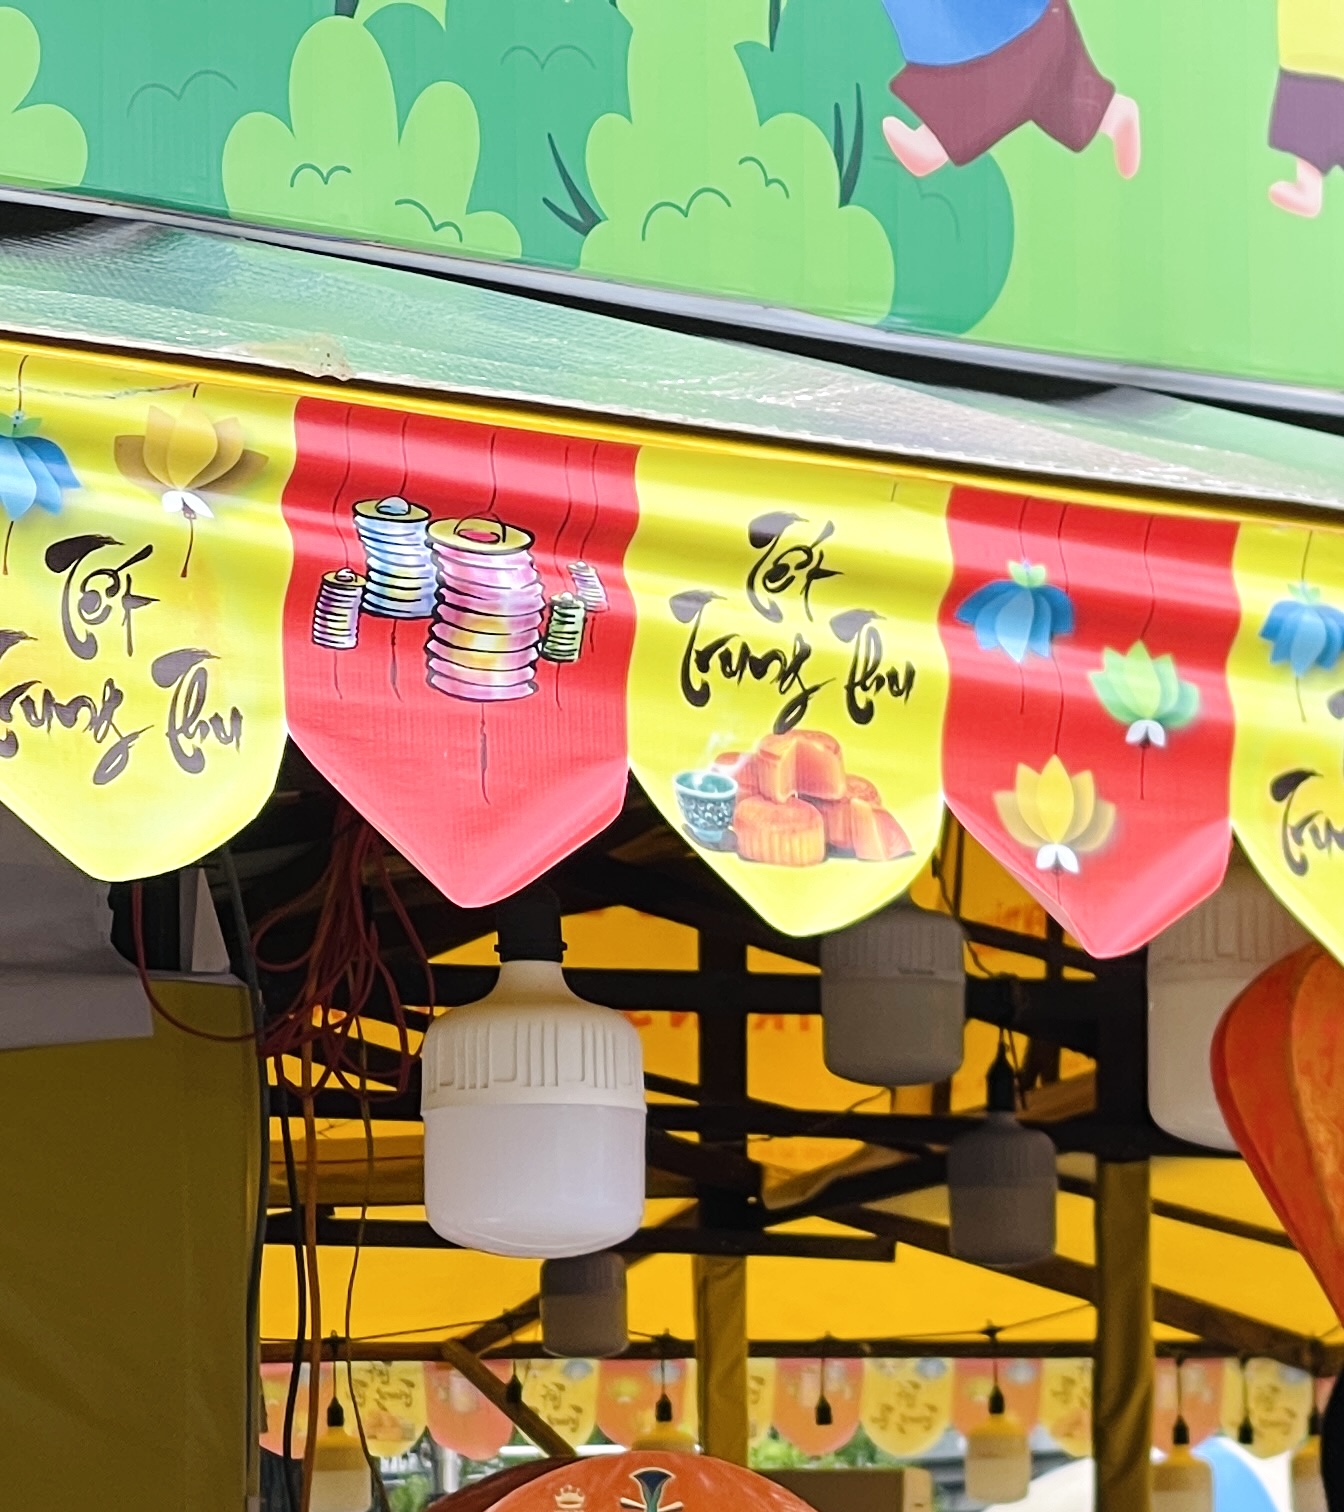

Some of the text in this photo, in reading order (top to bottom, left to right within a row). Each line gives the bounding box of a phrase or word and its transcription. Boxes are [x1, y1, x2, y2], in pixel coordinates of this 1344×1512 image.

[45, 534, 160, 660] Tết
[748, 511, 843, 622] Tết
[151, 648, 243, 774] Thu
[668, 589, 916, 733] Trung Thu
